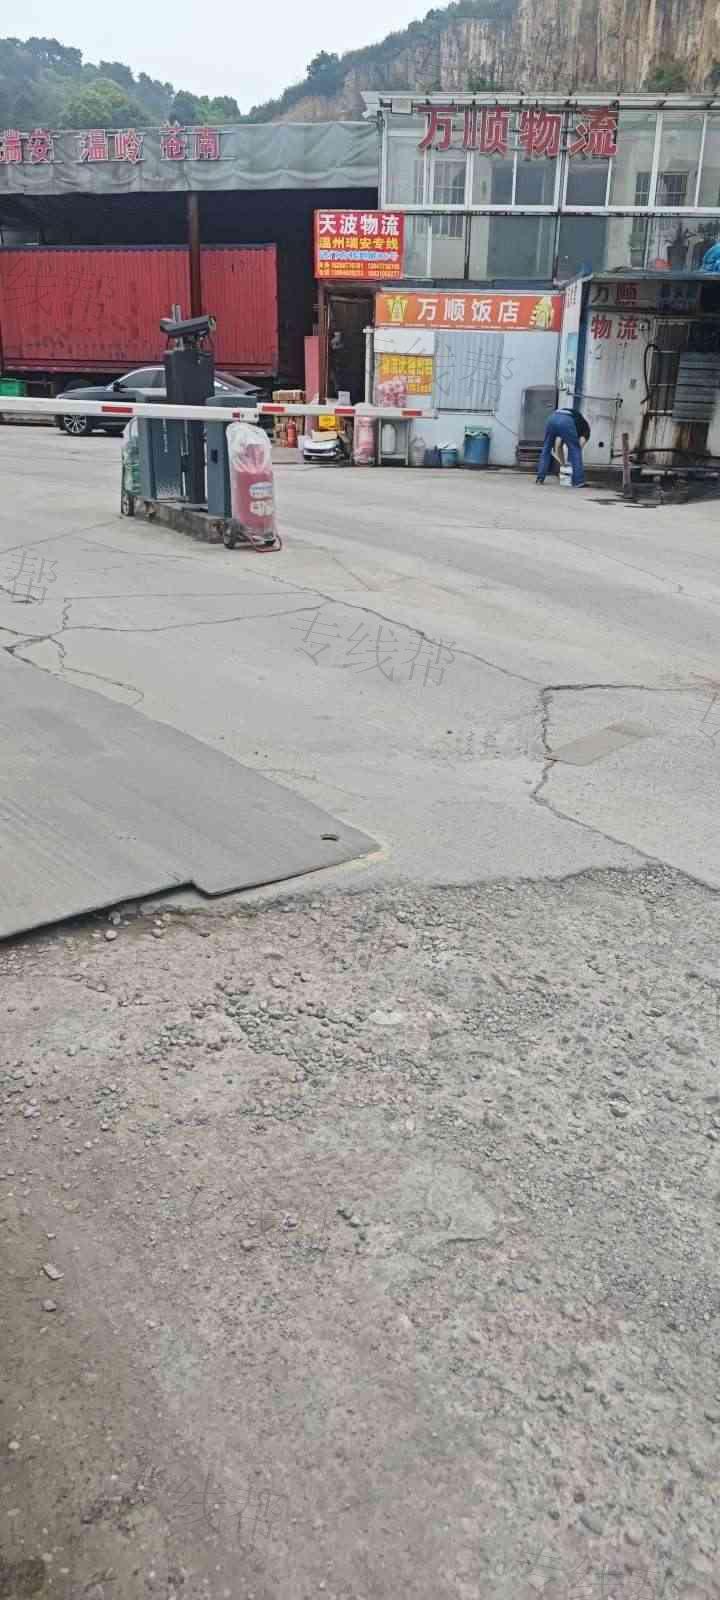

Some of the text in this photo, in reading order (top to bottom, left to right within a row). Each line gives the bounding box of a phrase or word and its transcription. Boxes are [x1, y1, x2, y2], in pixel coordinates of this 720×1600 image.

[0, 120, 221, 164] 瑞安 温岭 苍南
[416, 104, 619, 157] 万顺物流
[319, 213, 400, 235] 天波物流
[319, 236, 399, 250] 温州瑞安专线
[417, 297, 521, 323] 万顺饭店
[591, 313, 639, 341] 物流
